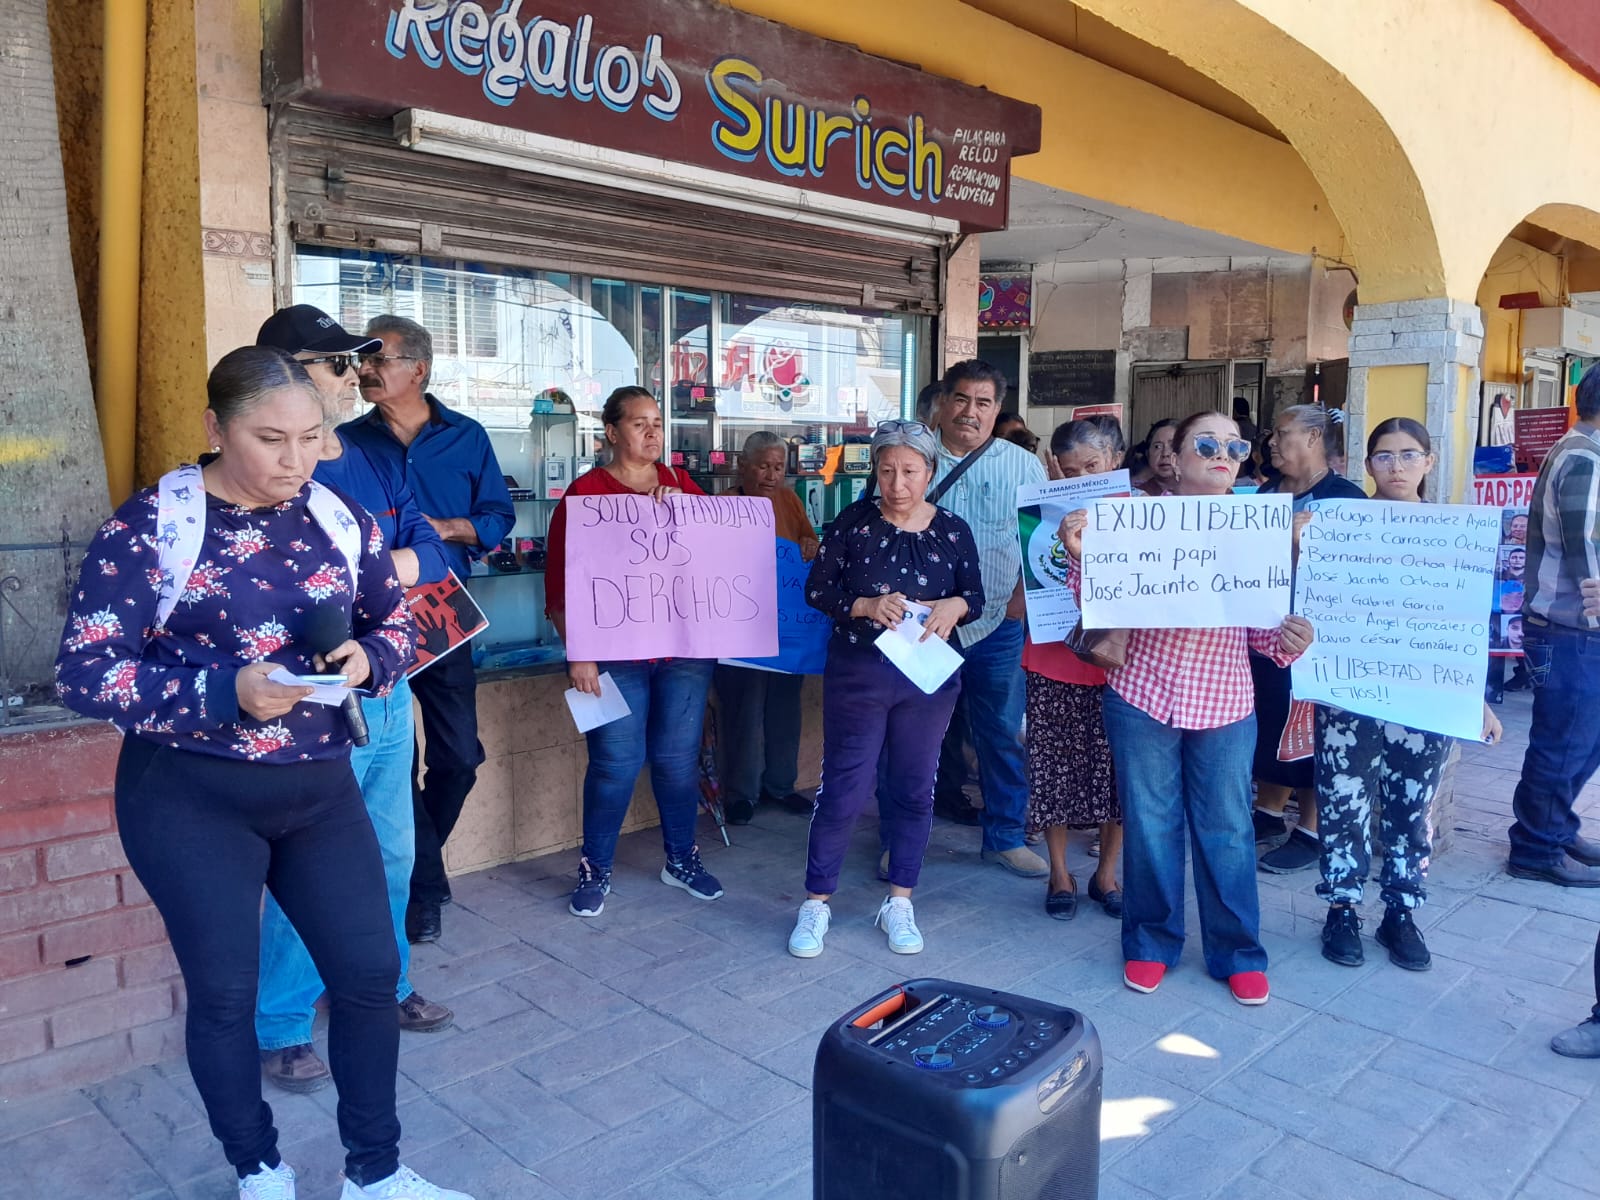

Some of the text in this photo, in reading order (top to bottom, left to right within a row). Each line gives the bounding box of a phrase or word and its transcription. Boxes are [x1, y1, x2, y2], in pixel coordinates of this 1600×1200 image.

[385, 0, 943, 204] Regalos Surich
[952, 128, 1006, 146] PILAS PARA
[958, 145, 998, 163] RELOJ
[948, 164, 1001, 191] REPARACION
[954, 184, 996, 207] JOYERIA
[1048, 484, 1081, 494] AMAMOS
[1081, 478, 1109, 488] MÉXICO
[583, 495, 770, 529] SOLO DEFENDIAN
[1095, 501, 1292, 532] EXIJO LIBERTAD
[1308, 502, 1499, 530] Refugio Hernandez Ayala
[629, 528, 692, 567] SUS
[1309, 525, 1496, 553] Dolores Carrasco Ochoa
[1084, 545, 1217, 576] para mi papi
[1308, 546, 1393, 565] Bernardino
[1400, 554, 1446, 569] Ochoa
[1084, 577, 1123, 602] José
[1128, 572, 1200, 597] Jacinto
[1211, 573, 1261, 593] Ochoa
[1344, 572, 1389, 586] Jacinto
[1400, 574, 1449, 589] Ochoa
[1456, 578, 1466, 590] H
[592, 572, 760, 629] DERCHOS
[1351, 593, 1395, 607] Gabriel
[1302, 607, 1357, 624] Ricardo
[1366, 611, 1400, 631] Angel
[1433, 664, 1475, 686] PARA
